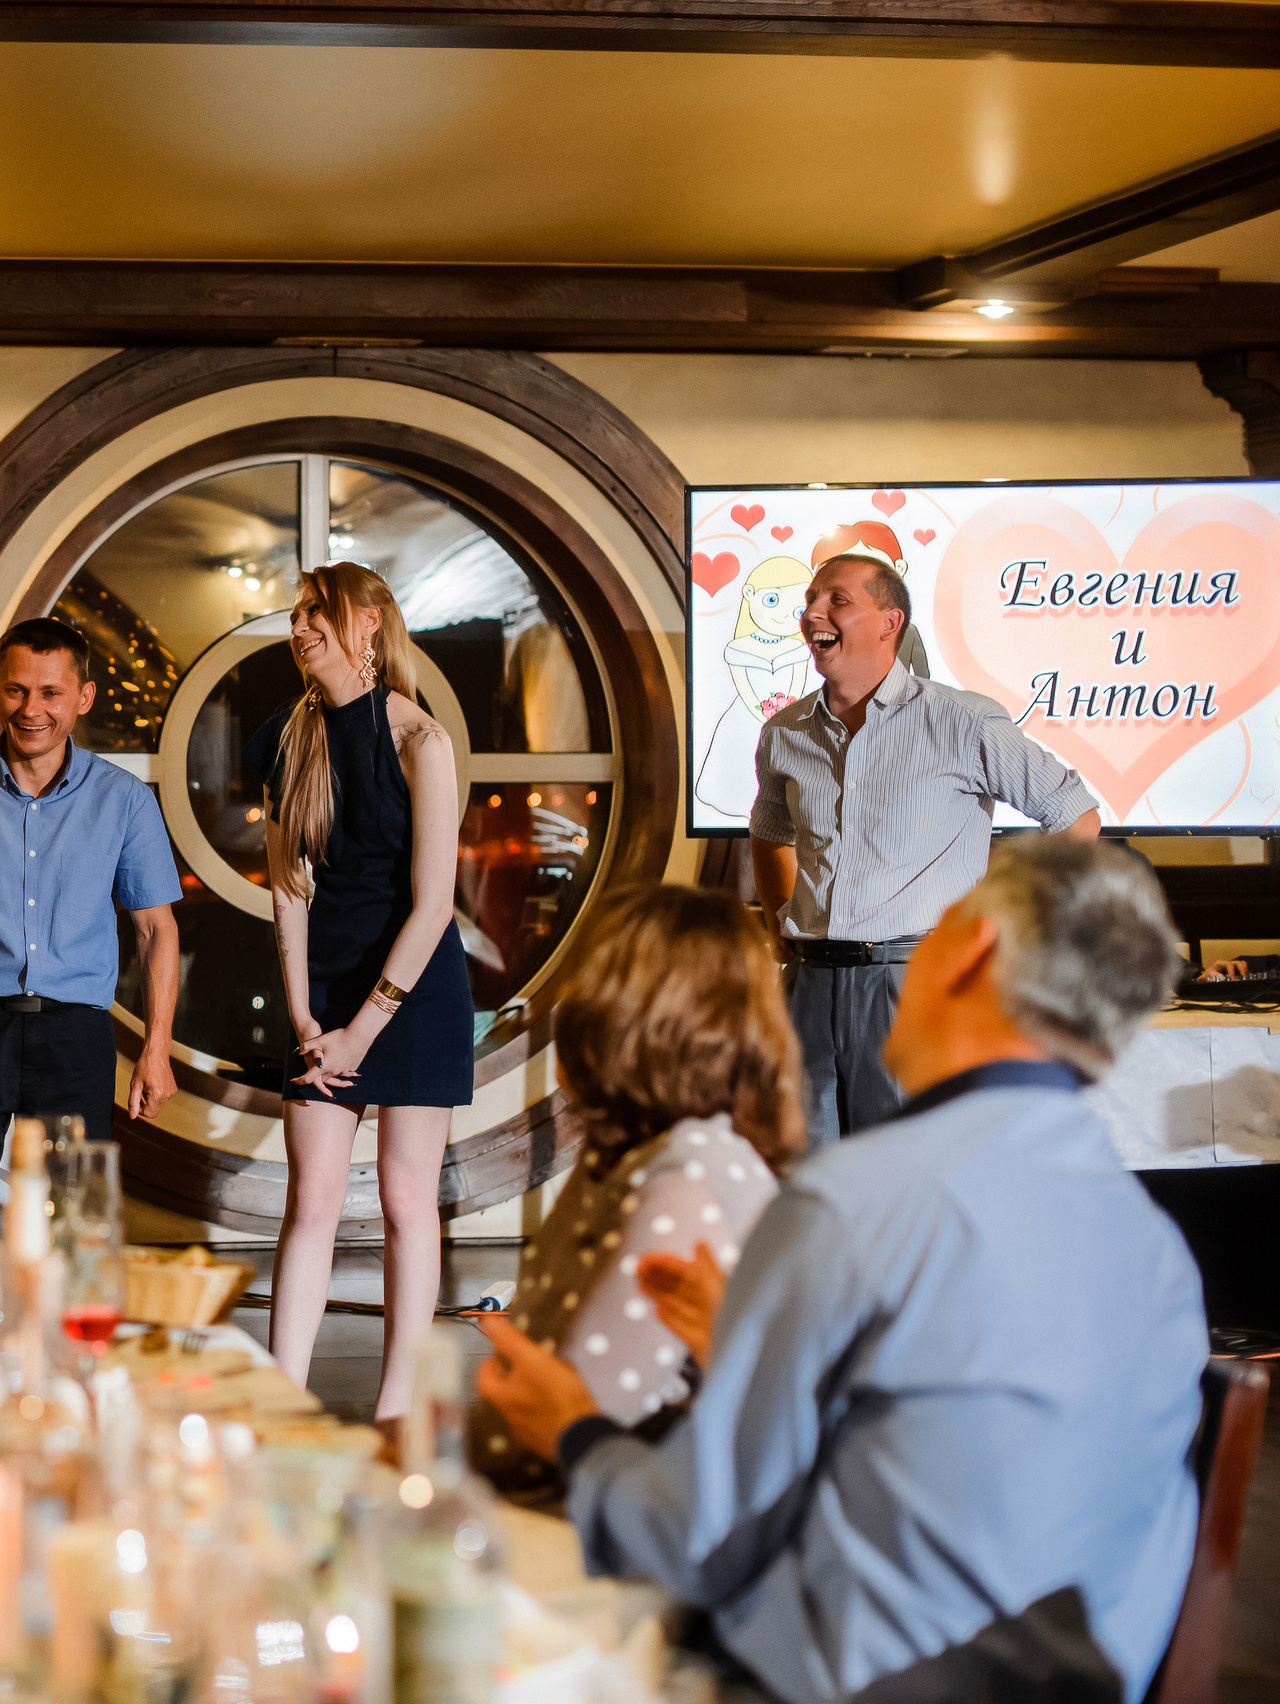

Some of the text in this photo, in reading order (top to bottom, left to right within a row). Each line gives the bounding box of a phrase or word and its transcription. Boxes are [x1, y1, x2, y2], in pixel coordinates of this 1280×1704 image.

[1000, 560, 1239, 607] Евгения
[1111, 629, 1147, 665] и
[1014, 669, 1217, 724] Антон
